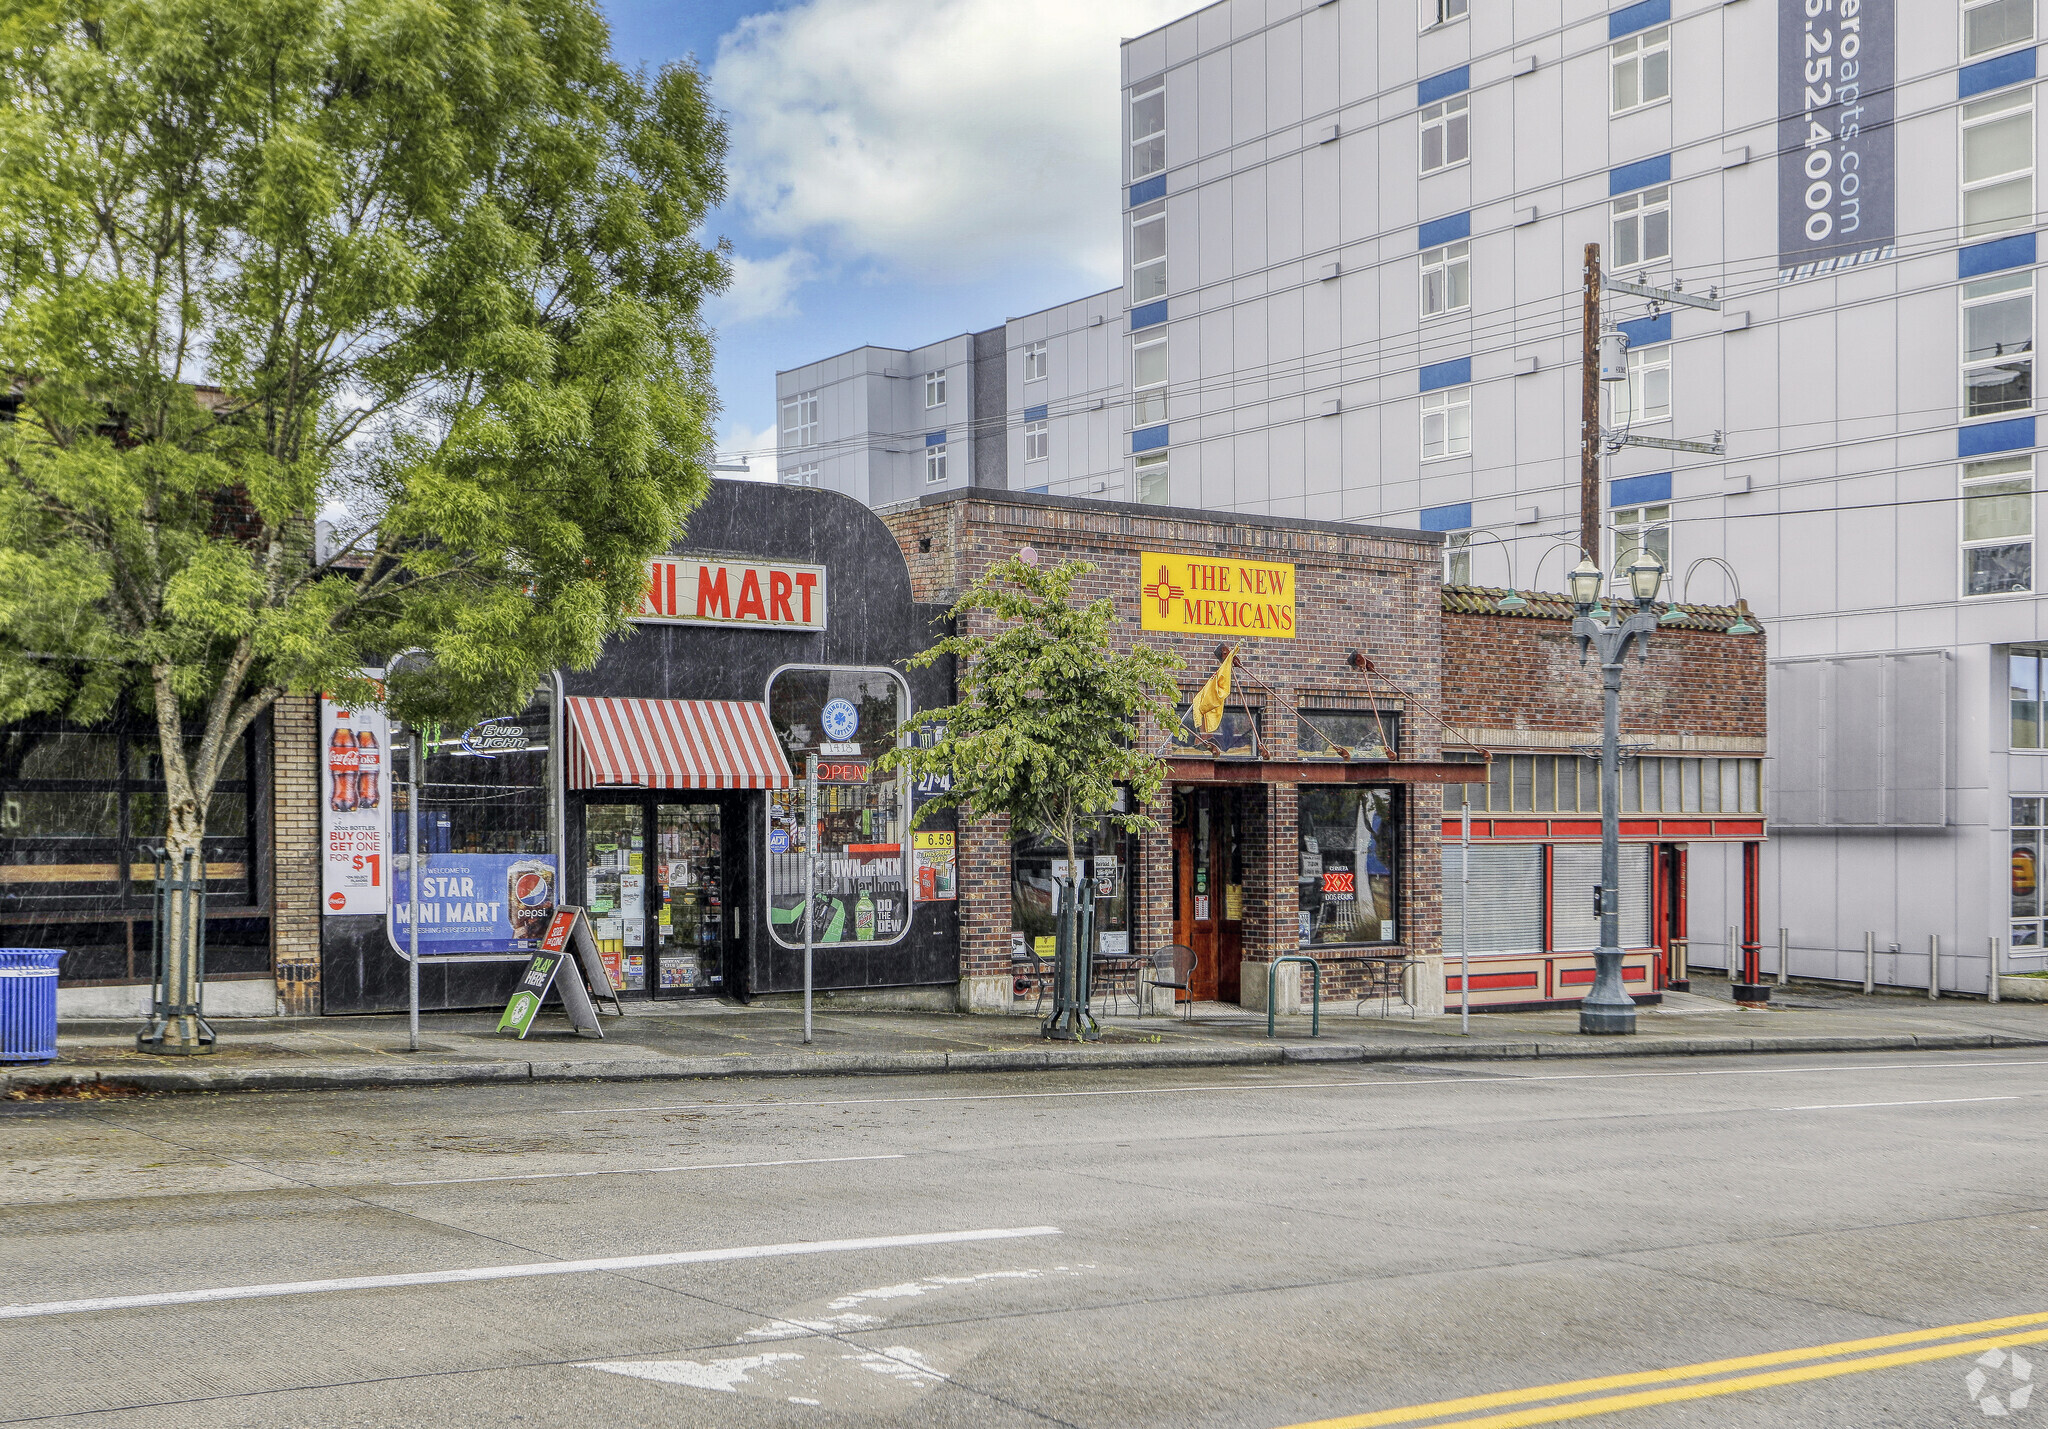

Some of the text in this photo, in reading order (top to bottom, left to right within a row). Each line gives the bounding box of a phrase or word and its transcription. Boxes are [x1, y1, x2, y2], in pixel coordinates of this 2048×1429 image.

[1836, 0, 1864, 234] eroapts.com
[1187, 564, 1287, 596] THE NEW
[696, 566, 818, 623] MART
[1183, 598, 1292, 631] MEXICANS
[825, 702, 854, 730] WASHINGTON'S
[482, 724, 523, 737] BUD
[834, 721, 854, 736] LOTTERY
[472, 736, 529, 749] LIGHT
[828, 743, 853, 754] 1418
[816, 763, 866, 781] OPEN
[329, 831, 380, 841] BUY ONE
[770, 835, 787, 845] ADT
[914, 833, 952, 846] $ 6.59
[330, 842, 380, 851] GET ONE
[329, 854, 380, 887] FOR $1
[832, 857, 901, 878] OWN THE MTN
[423, 877, 474, 898] STAR
[1323, 873, 1355, 892] XX
[877, 898, 893, 912] DO
[396, 902, 501, 924] MNI MART
[517, 908, 546, 919] pepsi
[877, 911, 891, 920] THE
[403, 926, 442, 934] REESHING
[877, 919, 902, 933] DEW
[531, 956, 555, 973] PLAY
[630, 965, 642, 973] VISA
[524, 971, 548, 987] HERE
